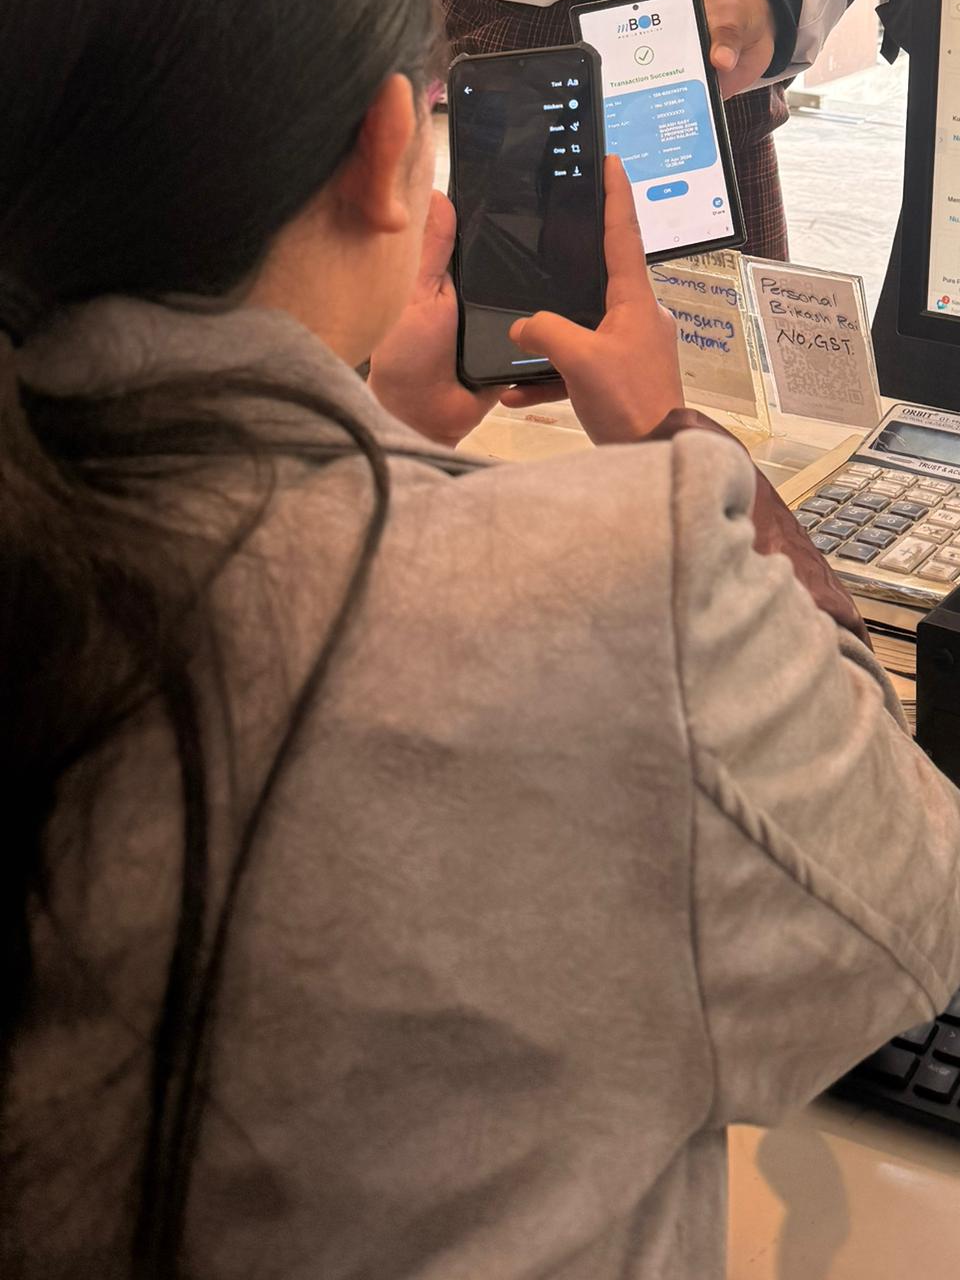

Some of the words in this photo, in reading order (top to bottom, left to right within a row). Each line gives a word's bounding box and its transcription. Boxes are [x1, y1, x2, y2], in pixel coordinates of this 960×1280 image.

[610, 76, 649, 88] Transaction
[650, 68, 686, 80] Successful
[942, 276, 956, 284] Pure
[760, 277, 838, 308] Personal
[769, 300, 831, 324] Bikash
[902, 408, 932, 420] ORBIT
[918, 462, 941, 470] TRUST
